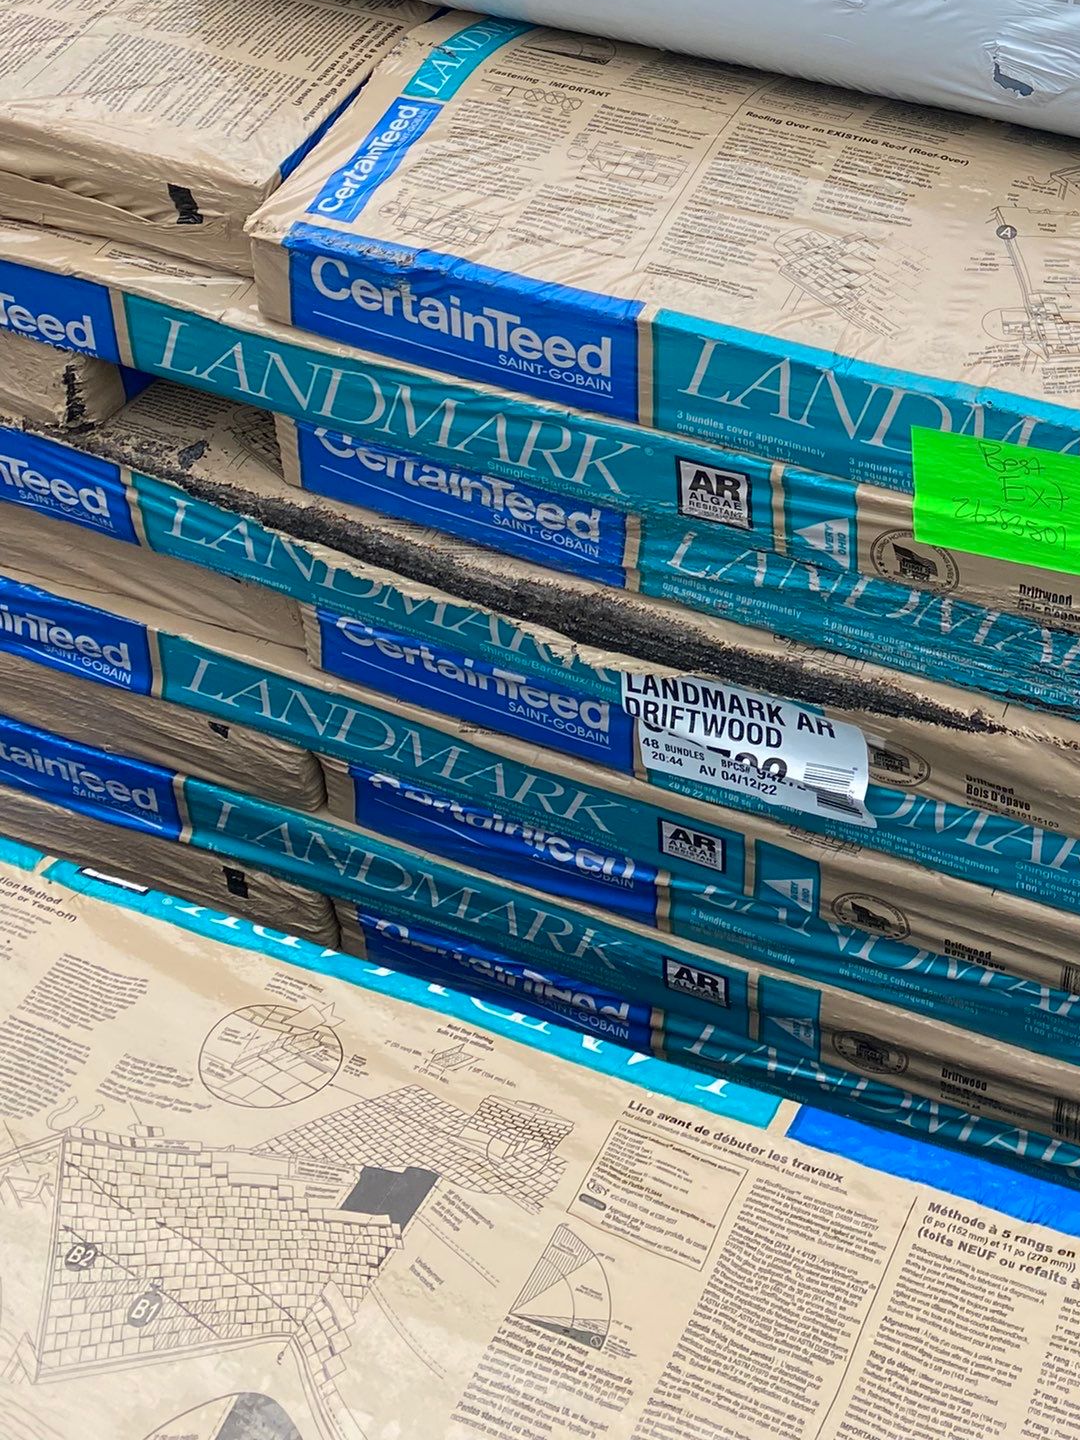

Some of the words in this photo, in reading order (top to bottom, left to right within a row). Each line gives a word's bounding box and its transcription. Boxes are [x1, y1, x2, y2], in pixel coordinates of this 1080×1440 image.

[488, 67, 540, 86] Fastening
[548, 79, 612, 100] IMPORTANT
[745, 110, 784, 129] Roofing
[785, 117, 812, 133] Over
[812, 124, 826, 135] an
[826, 128, 880, 147] EXISTING
[880, 138, 908, 154] Roof
[907, 145, 971, 168] (Roof-Over)
[316, 103, 420, 215] CertainTeed
[310, 254, 613, 379] CertainTeed
[498, 353, 613, 394] SAINT-GOBAIN
[153, 316, 642, 498] LANDMARK
[676, 422, 695, 433] one
[697, 427, 731, 445] square
[676, 410, 684, 419] 3
[686, 412, 725, 431] bundles
[726, 422, 754, 439] cover
[755, 429, 827, 460] approximately
[314, 426, 603, 544] CertainTeed
[688, 469, 742, 502] AR
[857, 459, 905, 477] paquetes
[688, 492, 744, 512] ALGAE
[998, 476, 1070, 510] Ext
[492, 513, 600, 558] SAINT-GOBAIN
[823, 522, 835, 557] AVERY
[837, 531, 847, 556] OHIO
[1018, 582, 1074, 608] Driftwood
[42, 642, 132, 686] SAINT-GOBAIN
[335, 615, 611, 733] CertainTeed
[507, 700, 610, 746] SAINT-GOBAIN
[624, 695, 783, 749] DRIFTWOOD
[625, 671, 787, 728] LANDMARK
[797, 711, 837, 740] AR
[181, 654, 628, 835] LANDMARK
[642, 736, 661, 751] 48
[664, 743, 706, 762] BUNDLES
[651, 751, 684, 768] 20:44
[720, 758, 751, 774] BPCS#
[699, 764, 717, 779] AV
[721, 771, 778, 796] 04/12/22
[965, 783, 991, 801] Bois
[667, 826, 718, 855] AR
[875, 827, 908, 846] cubren
[20, 883, 64, 907] Method
[215, 797, 628, 971] LANDMARK
[19, 895, 30, 905] or
[29, 898, 79, 924] Tear-off)
[627, 1099, 656, 1118] Lire
[656, 1113, 694, 1131] avant
[695, 1124, 711, 1138] de
[712, 1129, 767, 1157] débuter
[767, 1148, 789, 1166] les
[791, 1157, 845, 1184] travaux
[921, 1214, 933, 1229] (6
[933, 1219, 946, 1232] po
[946, 1221, 970, 1240] (152
[968, 1232, 989, 1248] mm)
[989, 1238, 1001, 1251] et
[1001, 1242, 1012, 1254] 11
[1012, 1245, 1025, 1259] po
[1026, 1248, 1049, 1266] (279
[1048, 1255, 1078, 1275] mm))
[926, 1200, 987, 1233] Méthode
[987, 1219, 999, 1236] à
[1001, 1229, 1012, 1241] 5
[1013, 1231, 1055, 1258] rangs
[1057, 1248, 1077, 1262] en
[67, 1245, 96, 1267] B2
[916, 1226, 956, 1252] (toits
[956, 1240, 997, 1263] NEUF
[998, 1257, 1018, 1272] ou
[1018, 1263, 1068, 1288] refaits
[130, 1298, 161, 1324] B1
